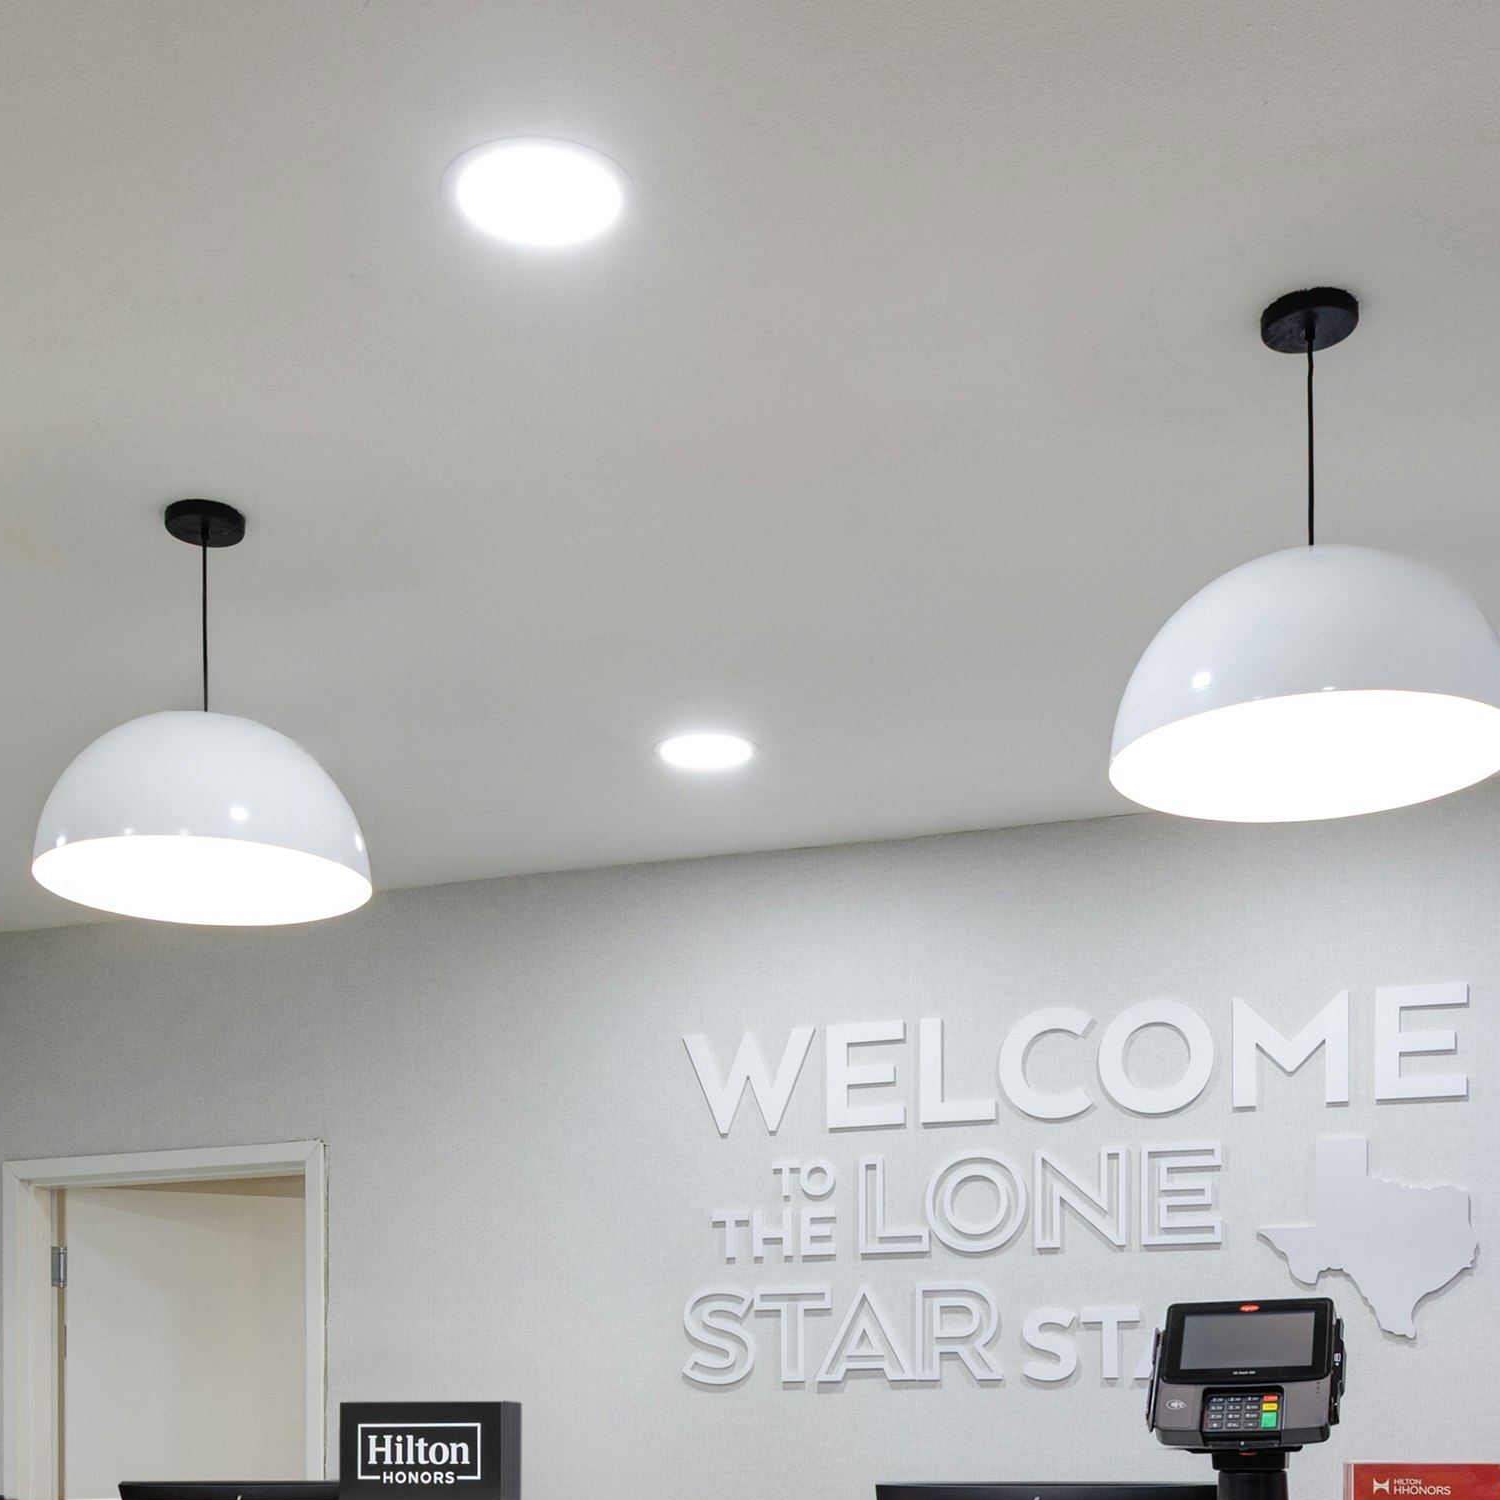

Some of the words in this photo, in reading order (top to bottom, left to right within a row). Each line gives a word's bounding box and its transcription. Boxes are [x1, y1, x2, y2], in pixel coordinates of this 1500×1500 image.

[682, 983, 1470, 1135] WELCOME
[772, 1160, 837, 1198] TO
[859, 1139, 1222, 1256] LONE
[712, 1208, 837, 1260] THE
[682, 1282, 1003, 1383] STAR
[368, 1435, 470, 1465] Hilton
[383, 1471, 455, 1484] HONORS
[1393, 1478, 1422, 1486] HILTON
[1393, 1485, 1451, 1495] HHONORS
